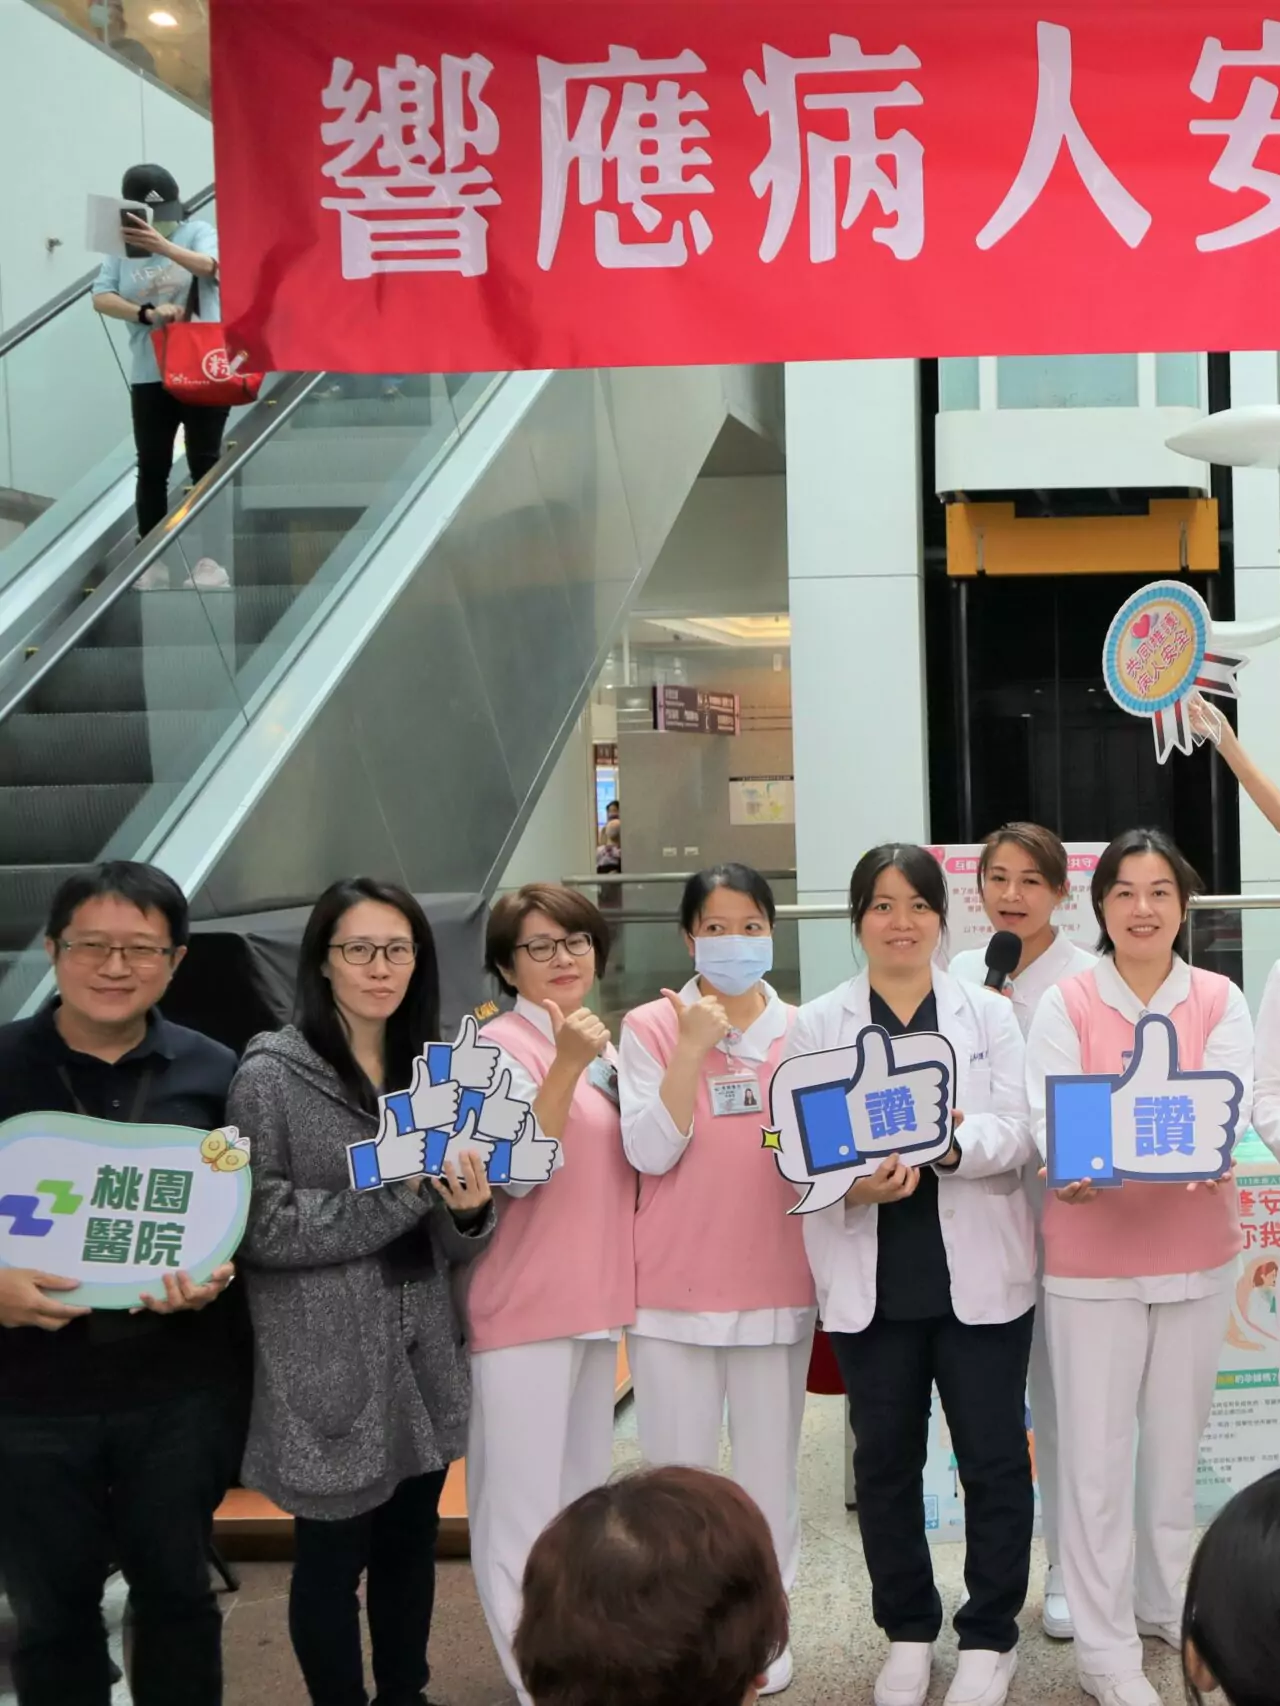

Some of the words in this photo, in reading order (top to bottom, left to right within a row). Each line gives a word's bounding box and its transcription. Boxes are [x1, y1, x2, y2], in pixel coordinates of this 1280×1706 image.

[1126, 610, 1180, 678] 共同維護
[1137, 629, 1192, 696] 病人安全
[864, 1085, 918, 1140] 讚
[1133, 1095, 1196, 1158] 讚
[90, 1164, 194, 1215] 桃園
[81, 1216, 186, 1268] 醫院
